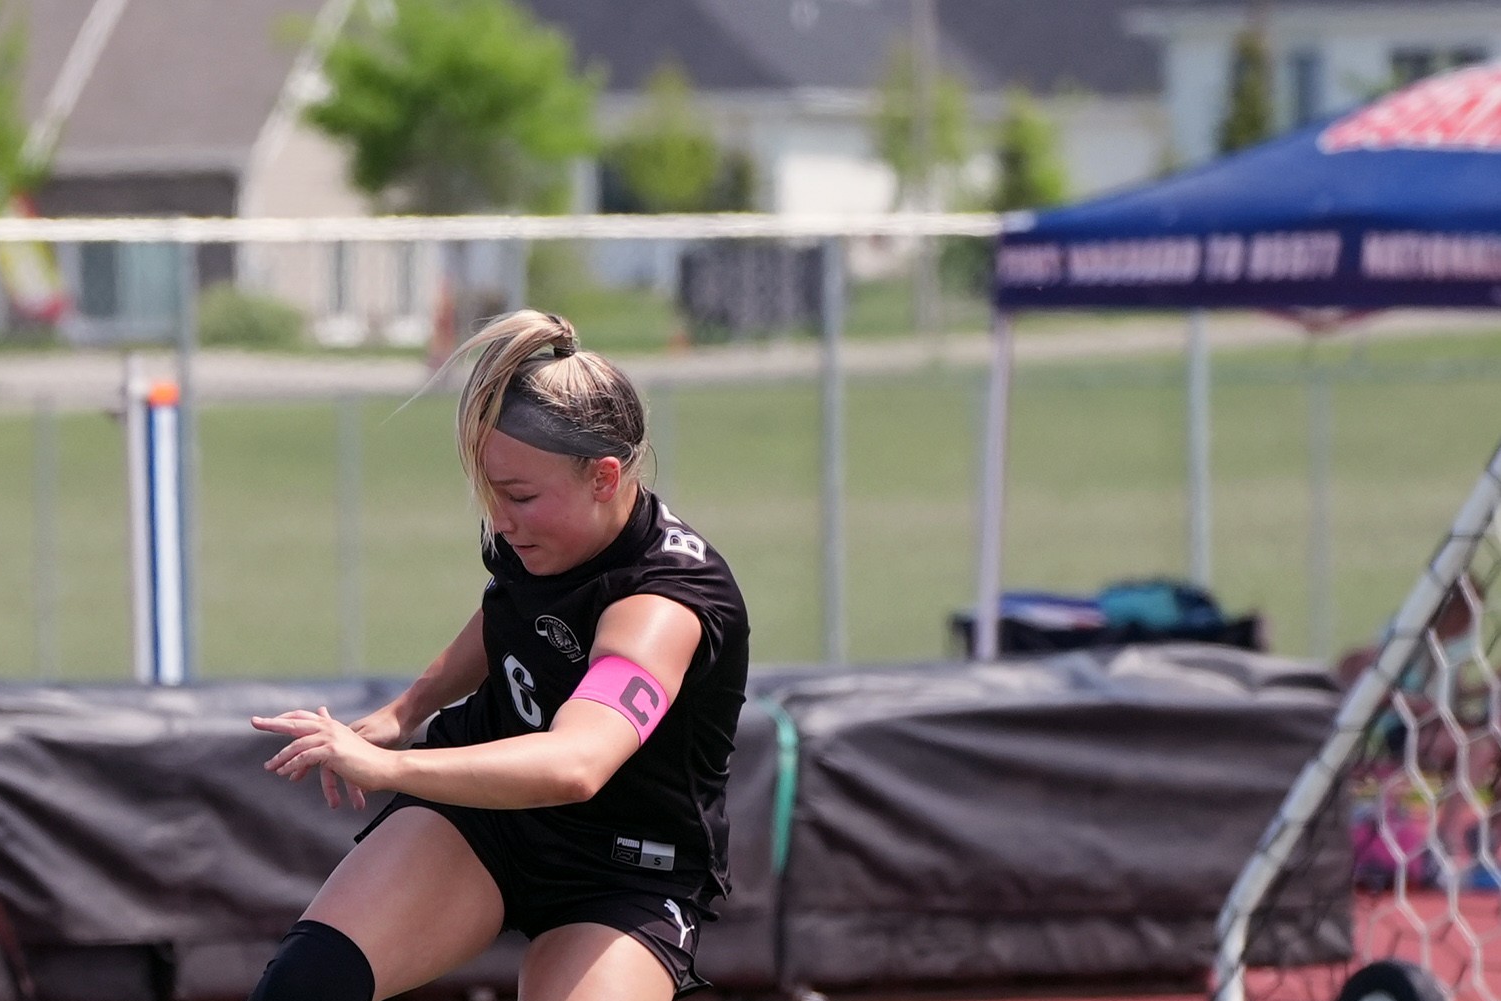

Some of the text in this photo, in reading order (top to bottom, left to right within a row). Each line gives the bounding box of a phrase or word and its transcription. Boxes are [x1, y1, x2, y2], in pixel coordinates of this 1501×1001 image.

[502, 652, 543, 729] 6
[619, 676, 659, 726] C
[617, 837, 640, 849] PUMA
[653, 857, 662, 866] S
